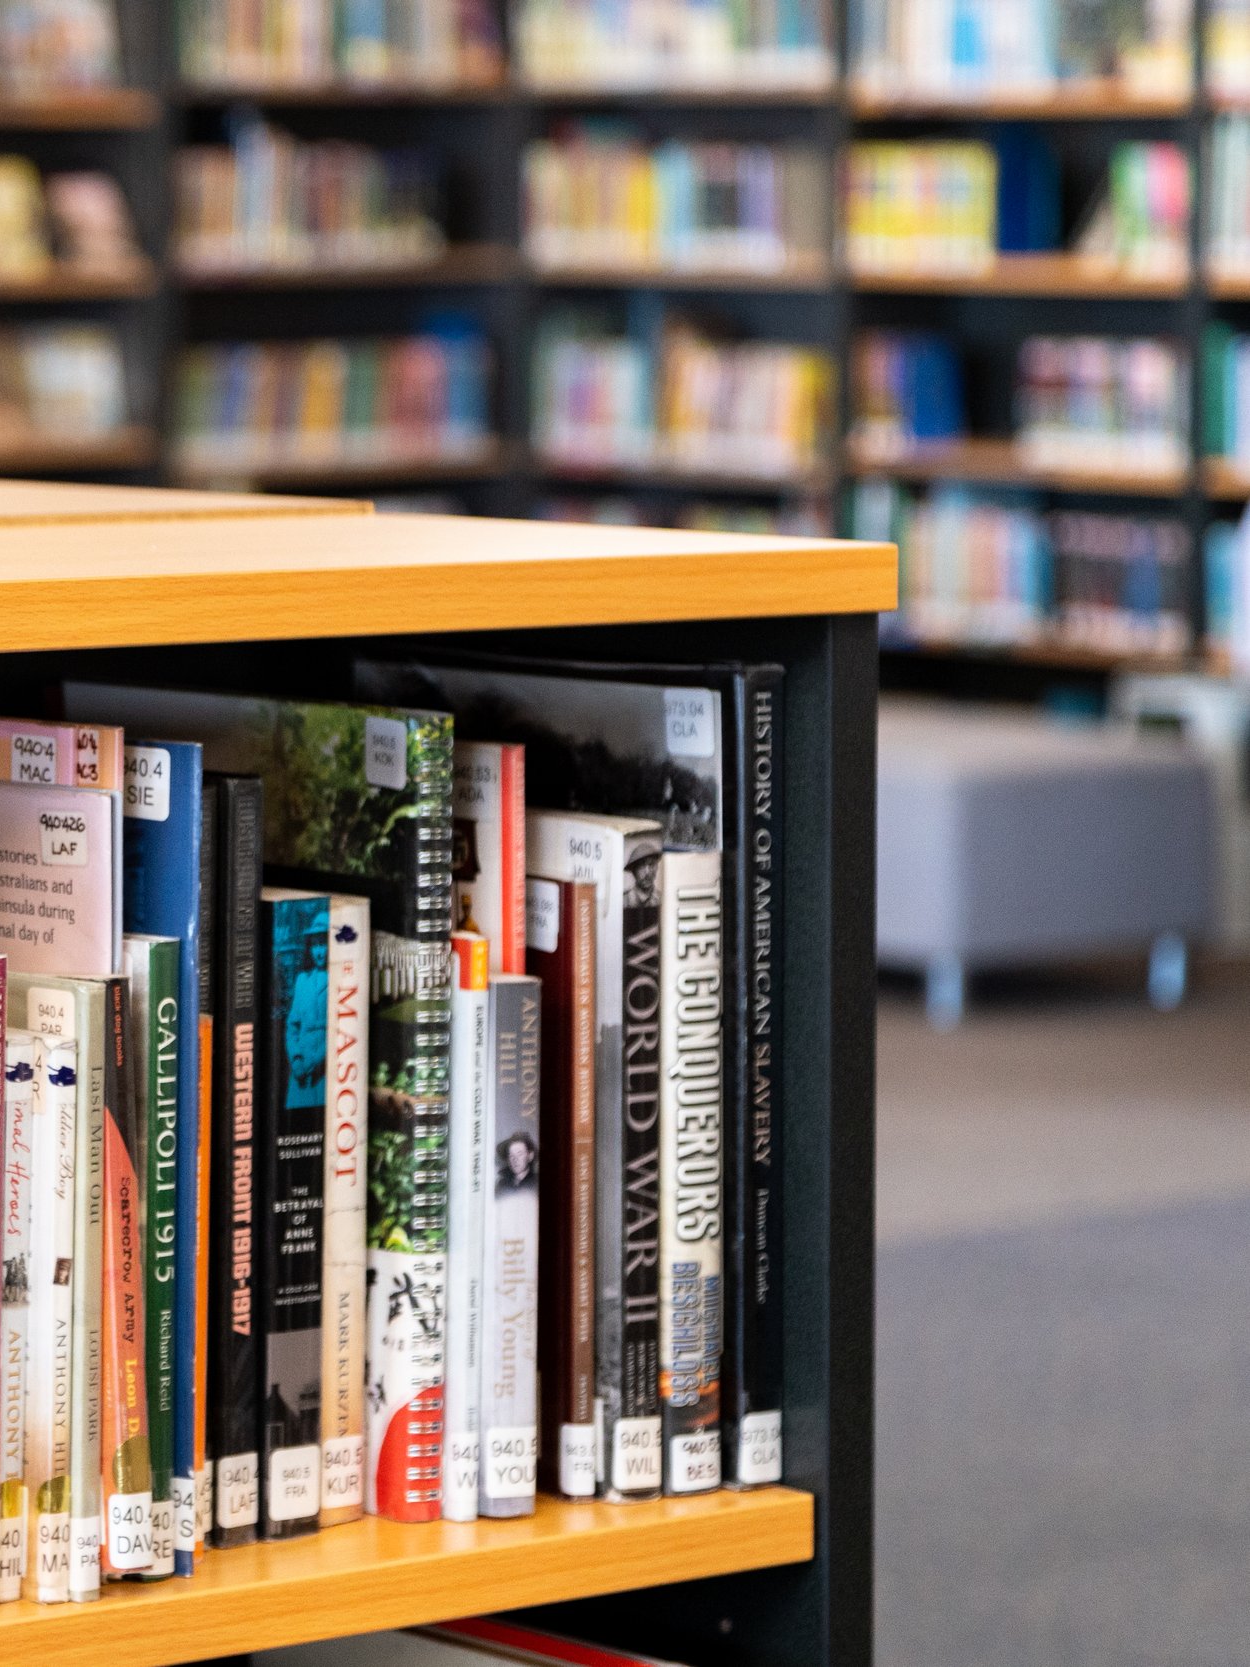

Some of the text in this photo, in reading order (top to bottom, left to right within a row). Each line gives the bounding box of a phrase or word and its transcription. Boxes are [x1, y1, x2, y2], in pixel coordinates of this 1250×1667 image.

[19, 763, 52, 783] MAC
[127, 786, 154, 807] SIE
[51, 842, 78, 857] LAF
[38, 902, 76, 925] during
[753, 691, 772, 1167] HISTORY OF AMERICAN SLAVERY
[500, 1032, 517, 1085] HILL
[521, 997, 538, 1120] ANTHONY
[670, 881, 721, 1243] THE CONQUERORS
[334, 985, 358, 1188] MASCOT
[625, 924, 659, 1324] WORLD WAR II
[90, 1066, 102, 1225] Last Man Out
[155, 997, 177, 1283] GALLIPOLI 1915
[277, 1132, 323, 1147] ROSEMARY
[279, 1147, 321, 1160] SULLIVAN
[291, 1186, 308, 1197] THE
[274, 1198, 324, 1213] BETRAYAL
[292, 1214, 308, 1226] OF
[284, 1228, 314, 1242] ANNE
[281, 1242, 317, 1256] FRANK
[119, 1177, 136, 1343] Scarecrow Army
[494, 1237, 526, 1398] Billy Young
[669, 1260, 702, 1407] BESCHLOSS
[159, 1309, 172, 1413] Richard Reid
[494, 1467, 536, 1485] YOU
[627, 1457, 658, 1475] WIL
[284, 1486, 308, 1498] FRA
[327, 1475, 359, 1495] KUR
